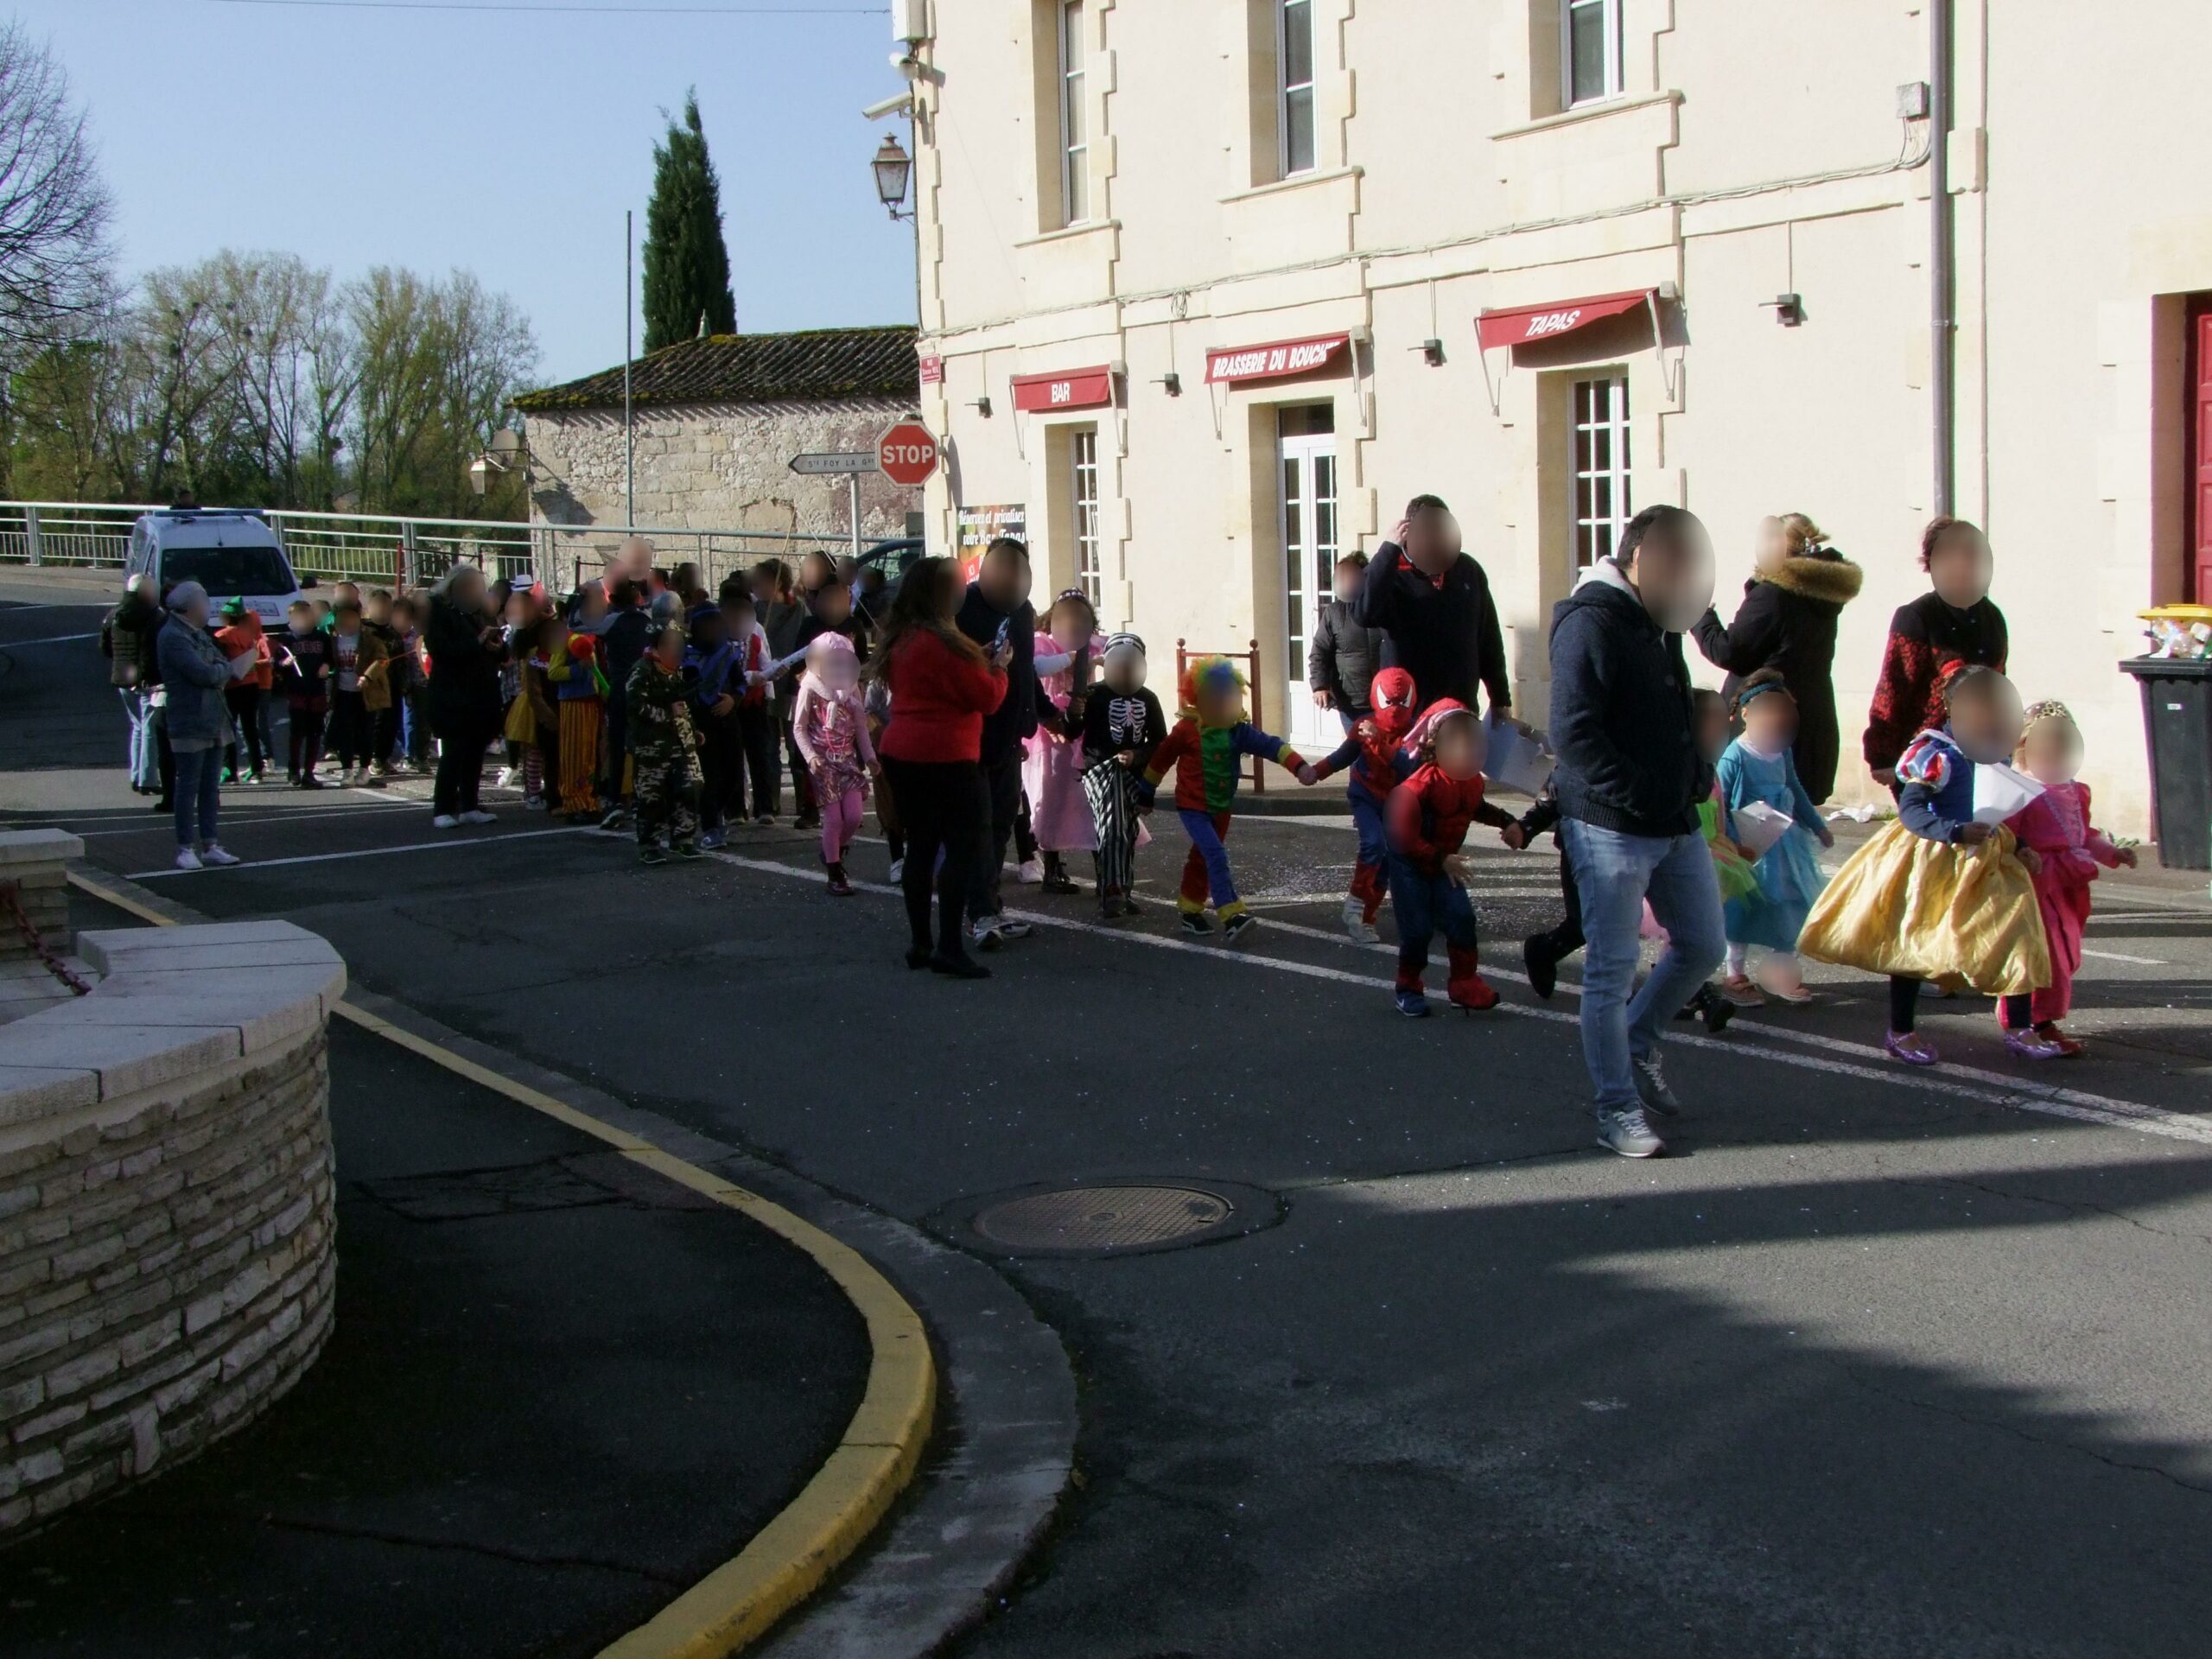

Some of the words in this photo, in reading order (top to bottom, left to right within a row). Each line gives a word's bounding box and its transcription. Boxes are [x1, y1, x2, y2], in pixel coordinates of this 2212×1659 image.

[1525, 310, 1580, 336] TAPAS
[1212, 351, 1268, 378] BRASSERIE
[1268, 349, 1287, 371] DU
[1051, 382, 1071, 404] BAR
[823, 459, 839, 467] FOY
[882, 445, 934, 464] STOP
[994, 508, 1025, 527] privatisez
[963, 532, 978, 545] votre
[979, 530, 996, 545] Bar
